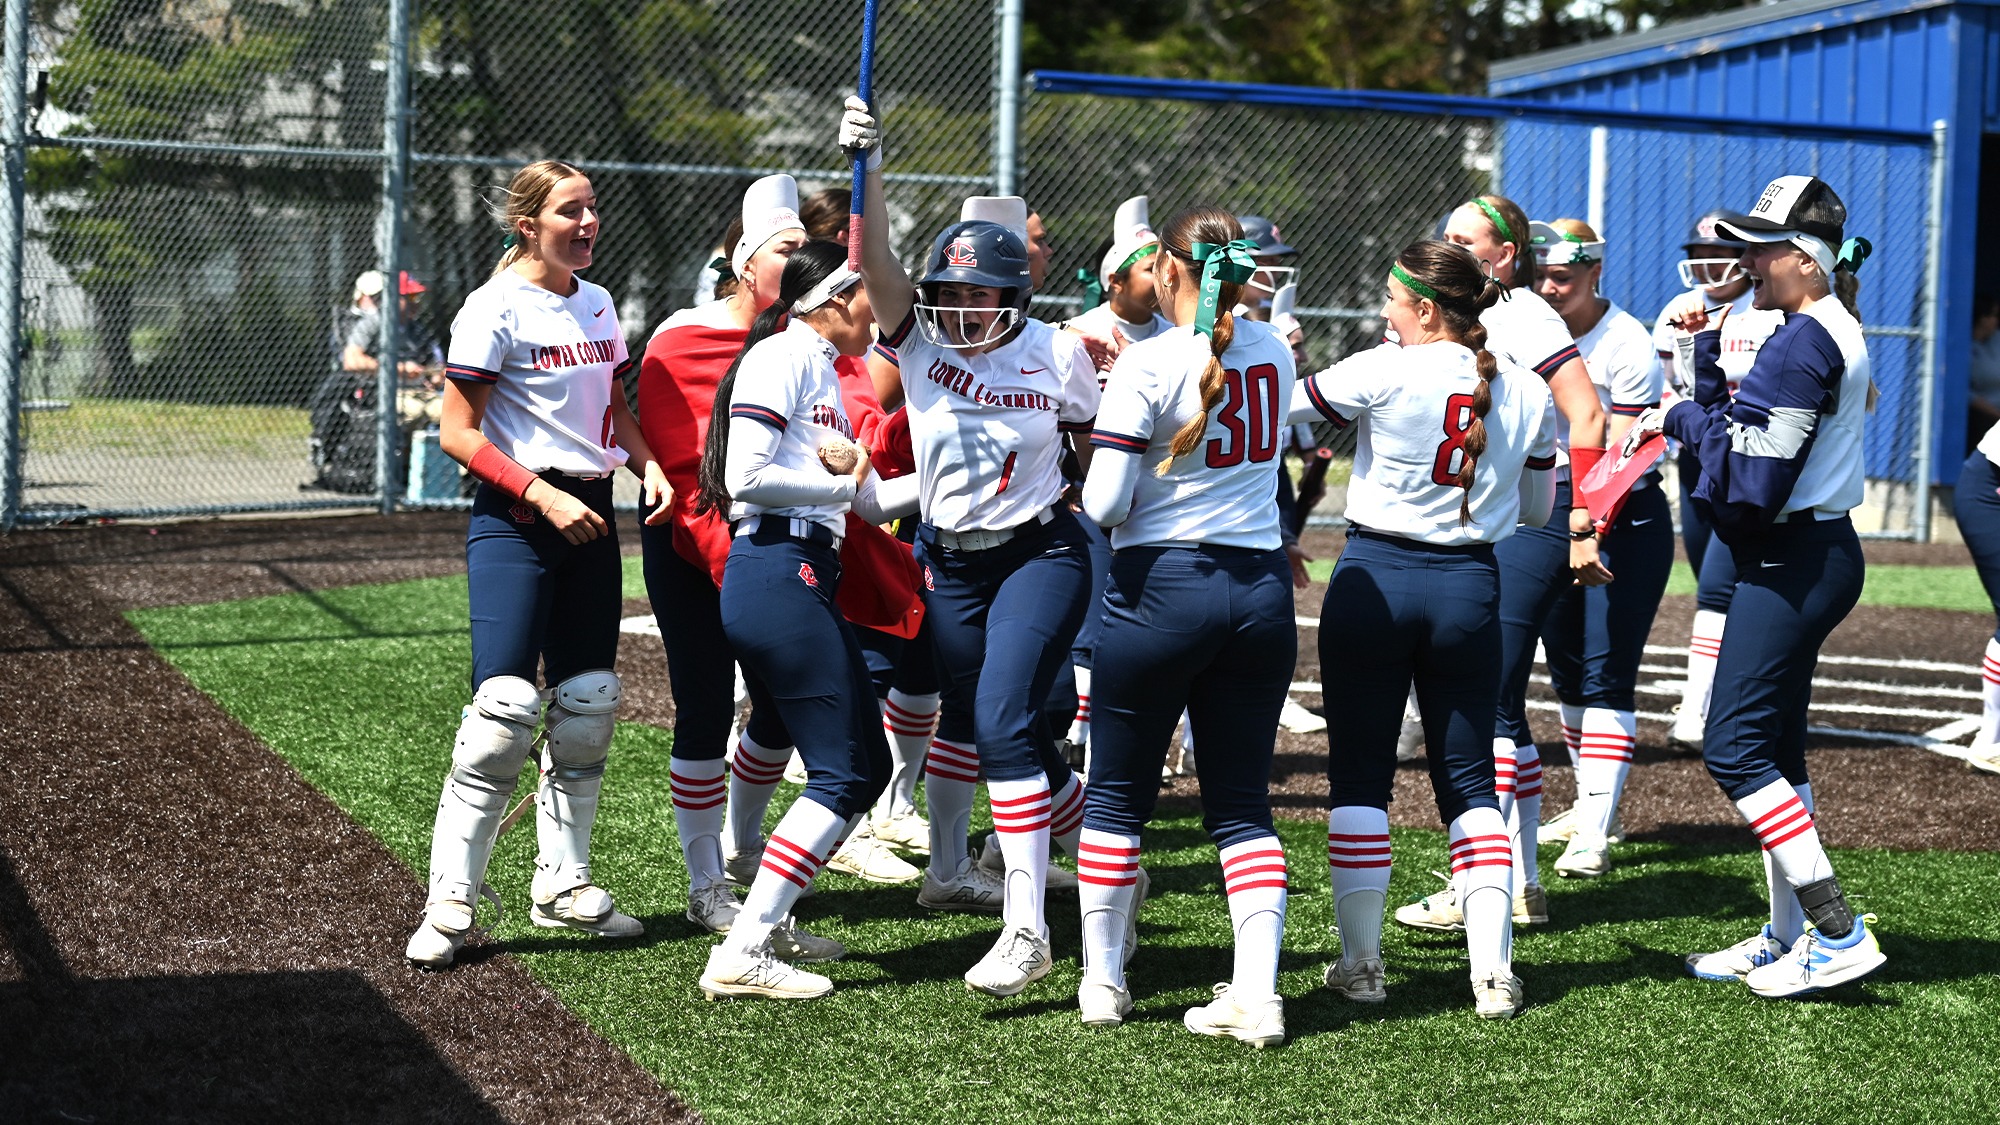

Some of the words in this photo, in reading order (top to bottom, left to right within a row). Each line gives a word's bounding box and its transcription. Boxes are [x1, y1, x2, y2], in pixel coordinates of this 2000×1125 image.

[530, 344, 578, 371] LOWER
[576, 339, 616, 365] COLUM
[927, 357, 975, 397] LOWER
[974, 382, 1051, 411] COLUMBIA
[1205, 362, 1279, 469] 30
[1431, 393, 1479, 488] 8
[994, 450, 1018, 497] 1
